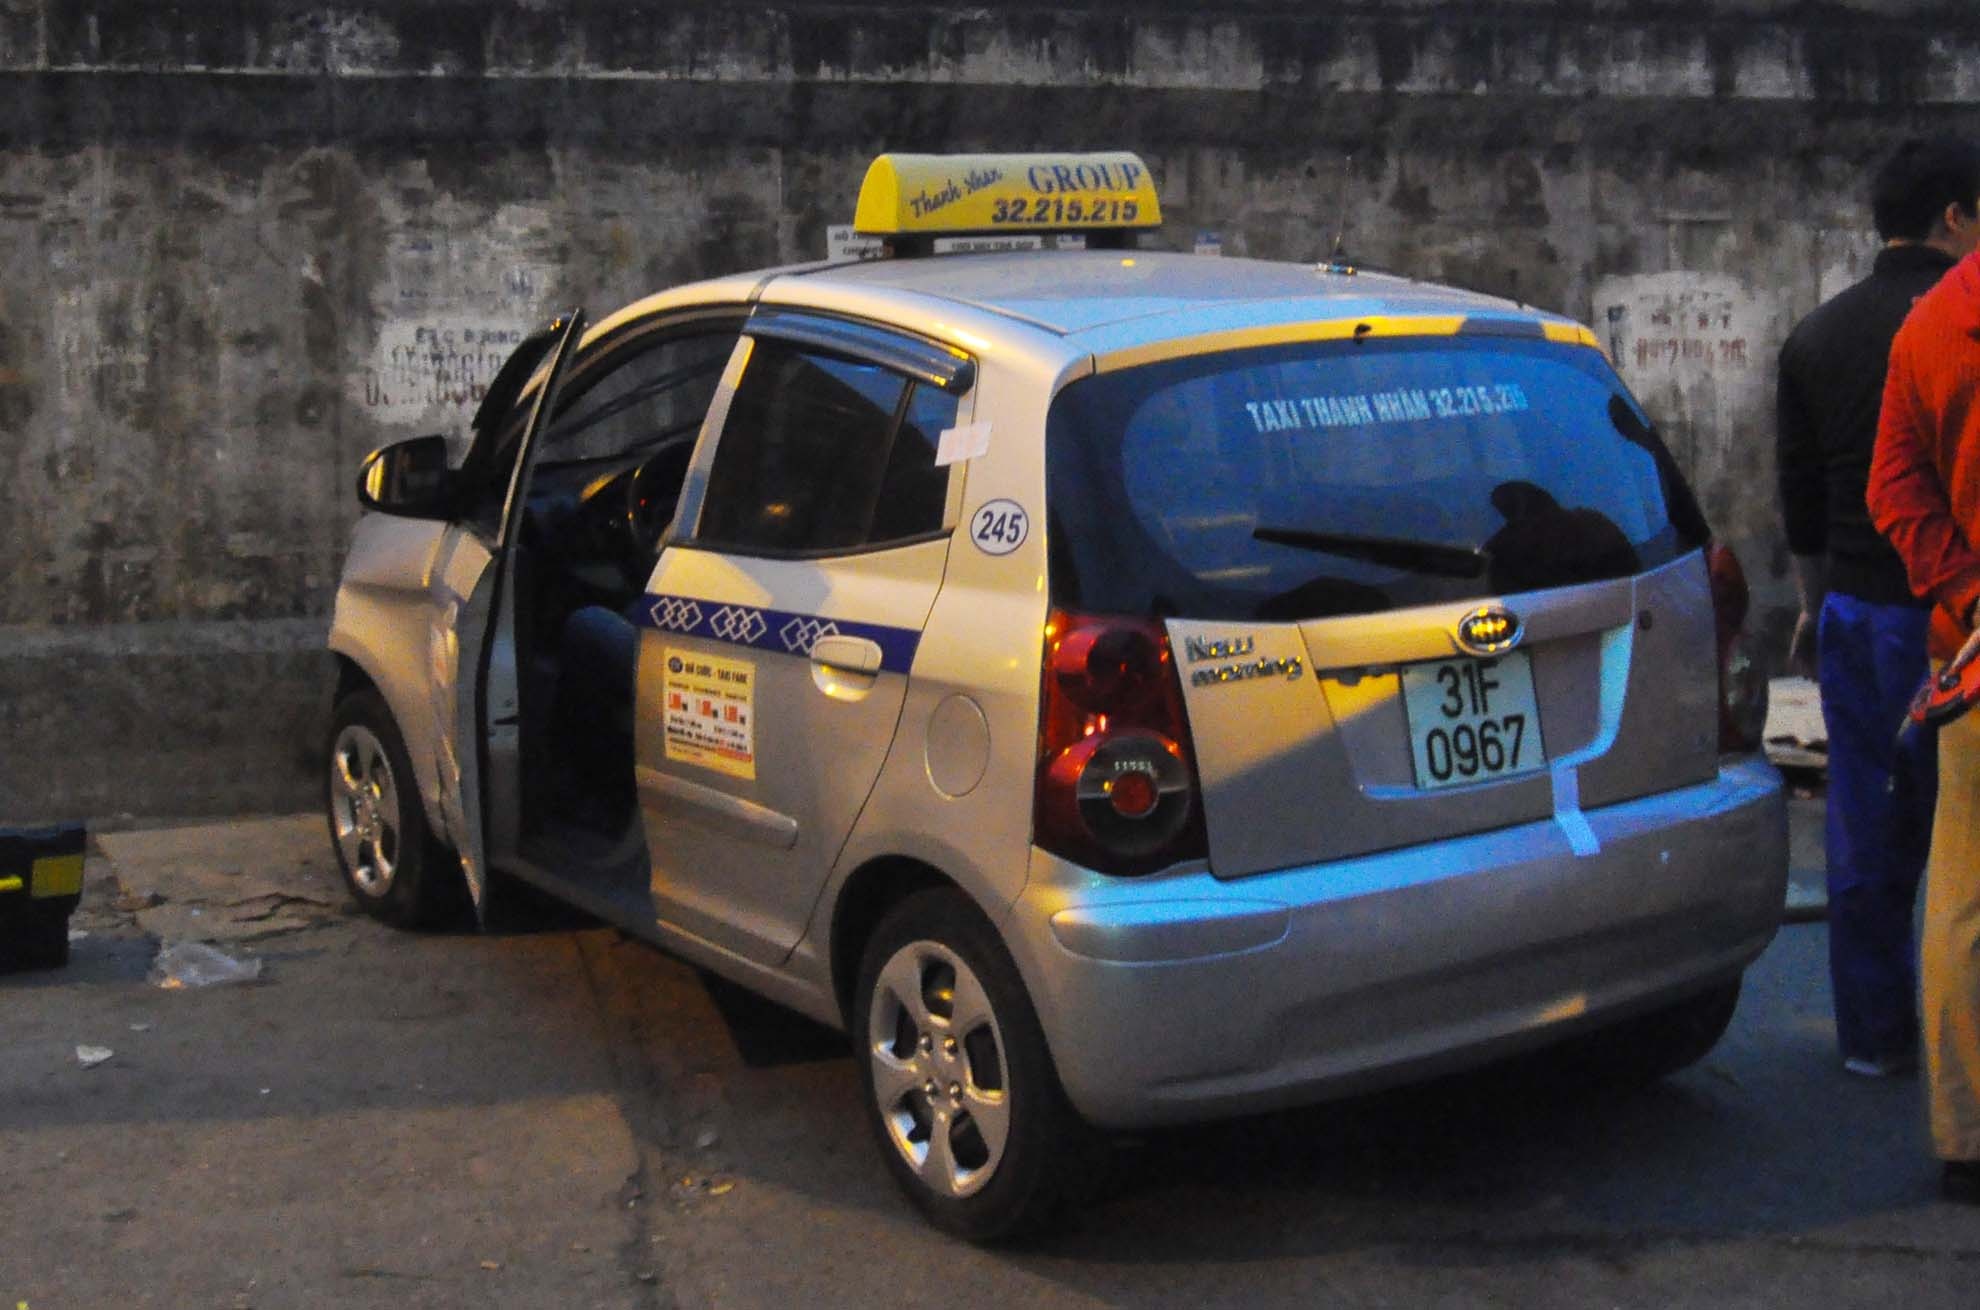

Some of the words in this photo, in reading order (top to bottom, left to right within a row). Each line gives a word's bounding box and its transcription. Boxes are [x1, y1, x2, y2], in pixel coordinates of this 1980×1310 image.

[1028, 162, 1141, 194] GROUP
[991, 196, 1138, 224] 32.215.215
[1246, 399, 1301, 433] TAXI
[977, 510, 1022, 544] 245
[1436, 661, 1500, 719] 31F
[1425, 713, 1526, 782] 0967
